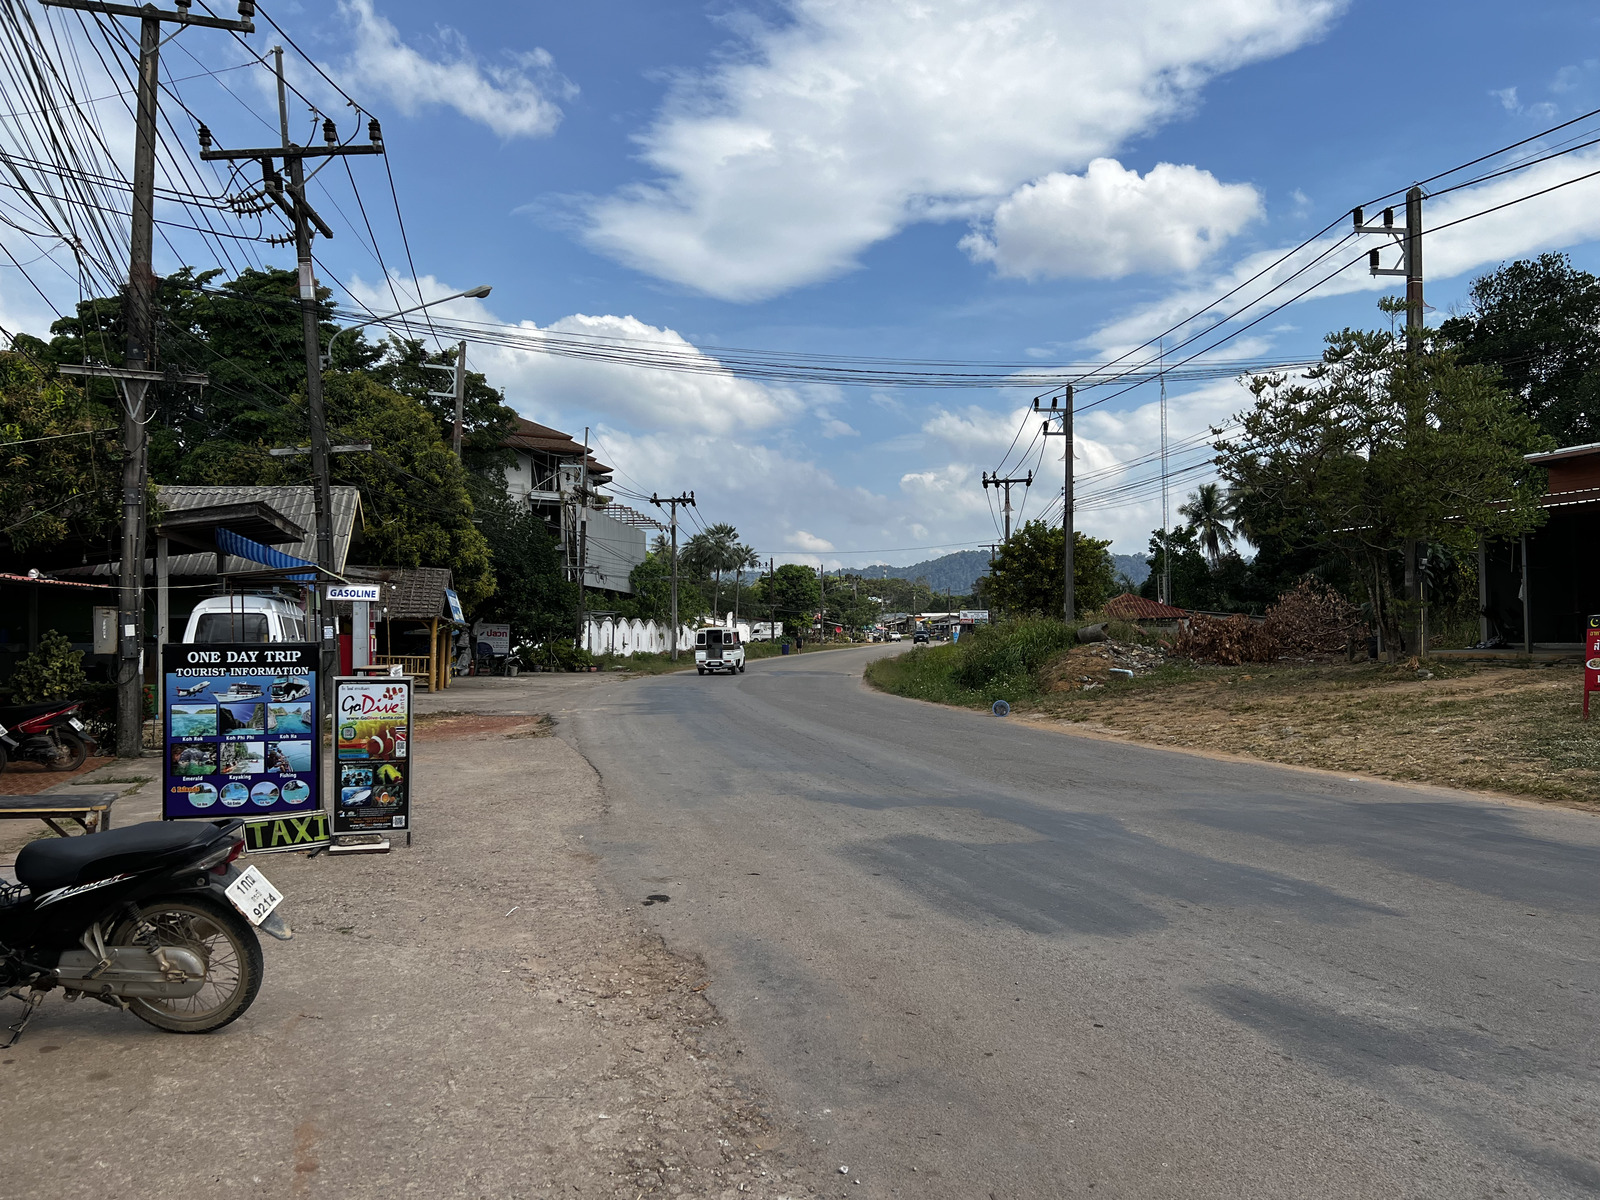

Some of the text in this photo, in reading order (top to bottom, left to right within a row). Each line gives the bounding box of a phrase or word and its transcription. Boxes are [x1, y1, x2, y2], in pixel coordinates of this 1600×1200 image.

[330, 589, 376, 598] GASOLINE
[187, 651, 301, 663] ONE DAY TRIP
[176, 666, 309, 677] TOURIST INFORMATION
[342, 694, 399, 715] GoDive
[246, 815, 329, 848] TAXI
[253, 892, 277, 918] 9214
